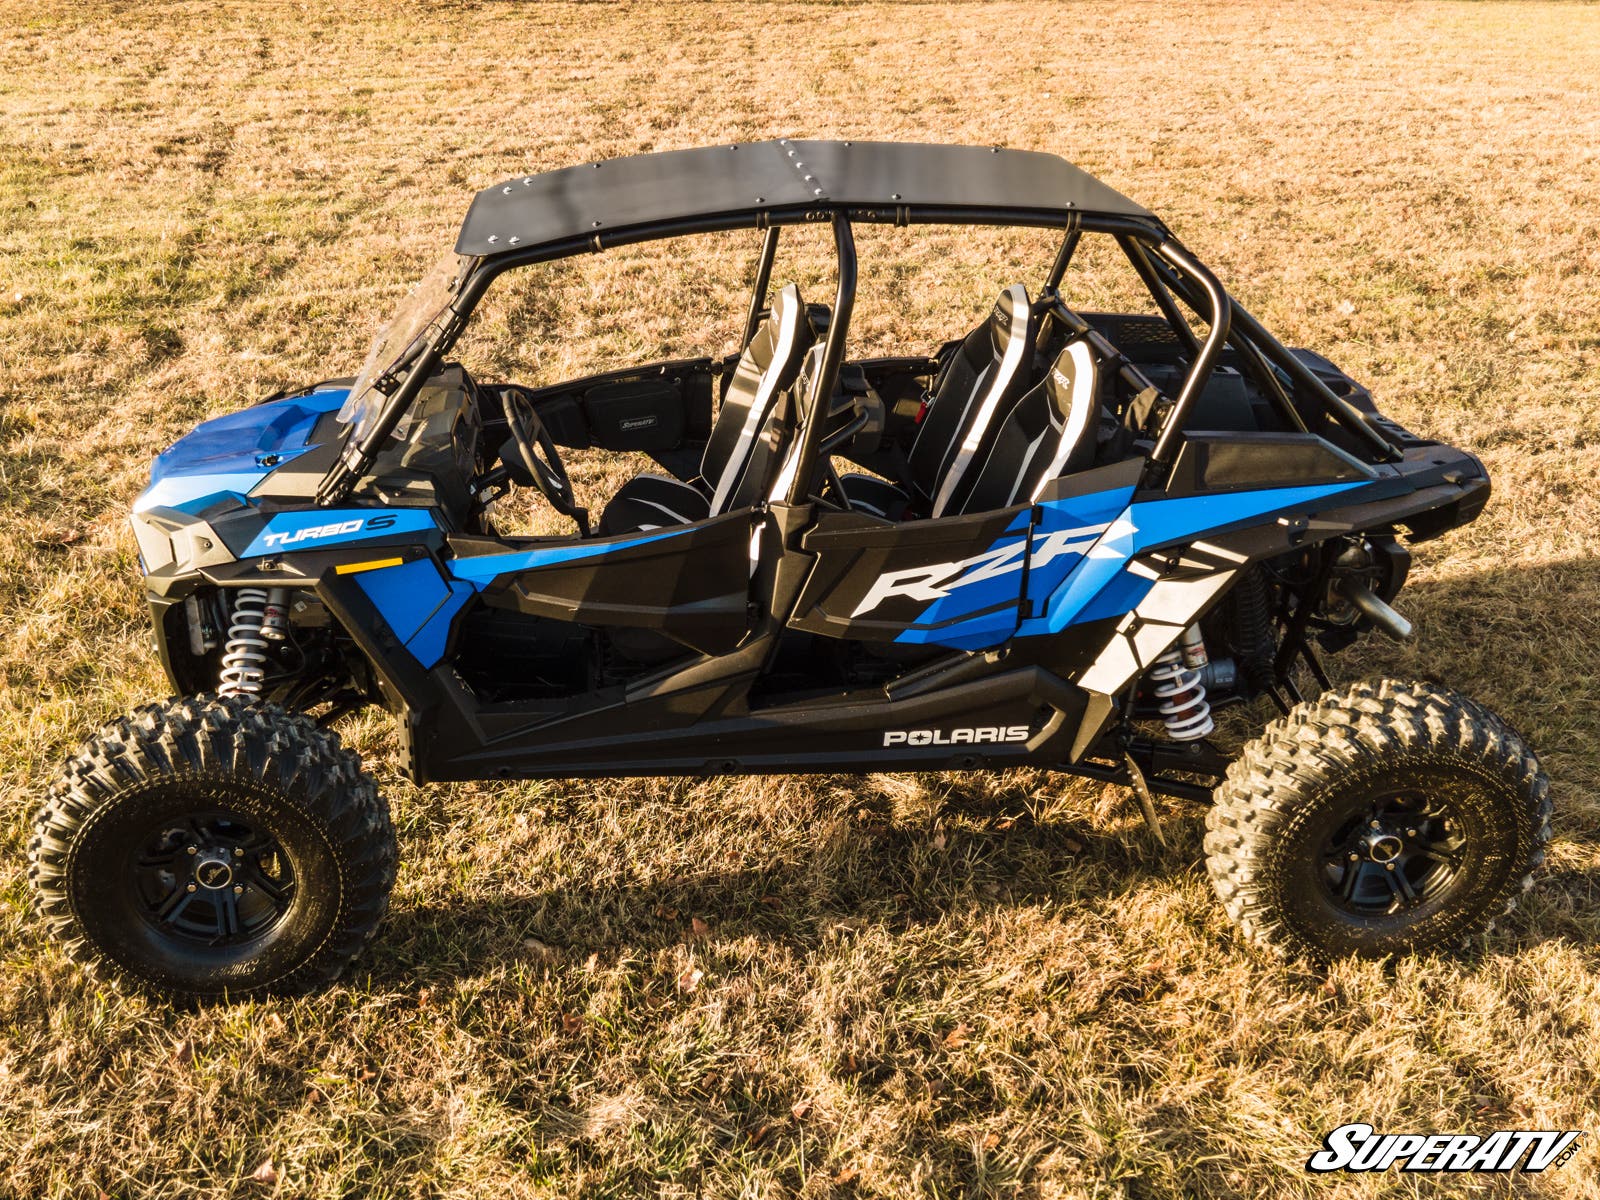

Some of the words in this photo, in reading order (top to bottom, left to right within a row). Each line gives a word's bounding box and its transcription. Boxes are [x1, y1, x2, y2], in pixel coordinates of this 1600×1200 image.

[263, 519, 364, 547] TURBO
[365, 514, 398, 531] S
[883, 725, 1029, 747] POLARIS
